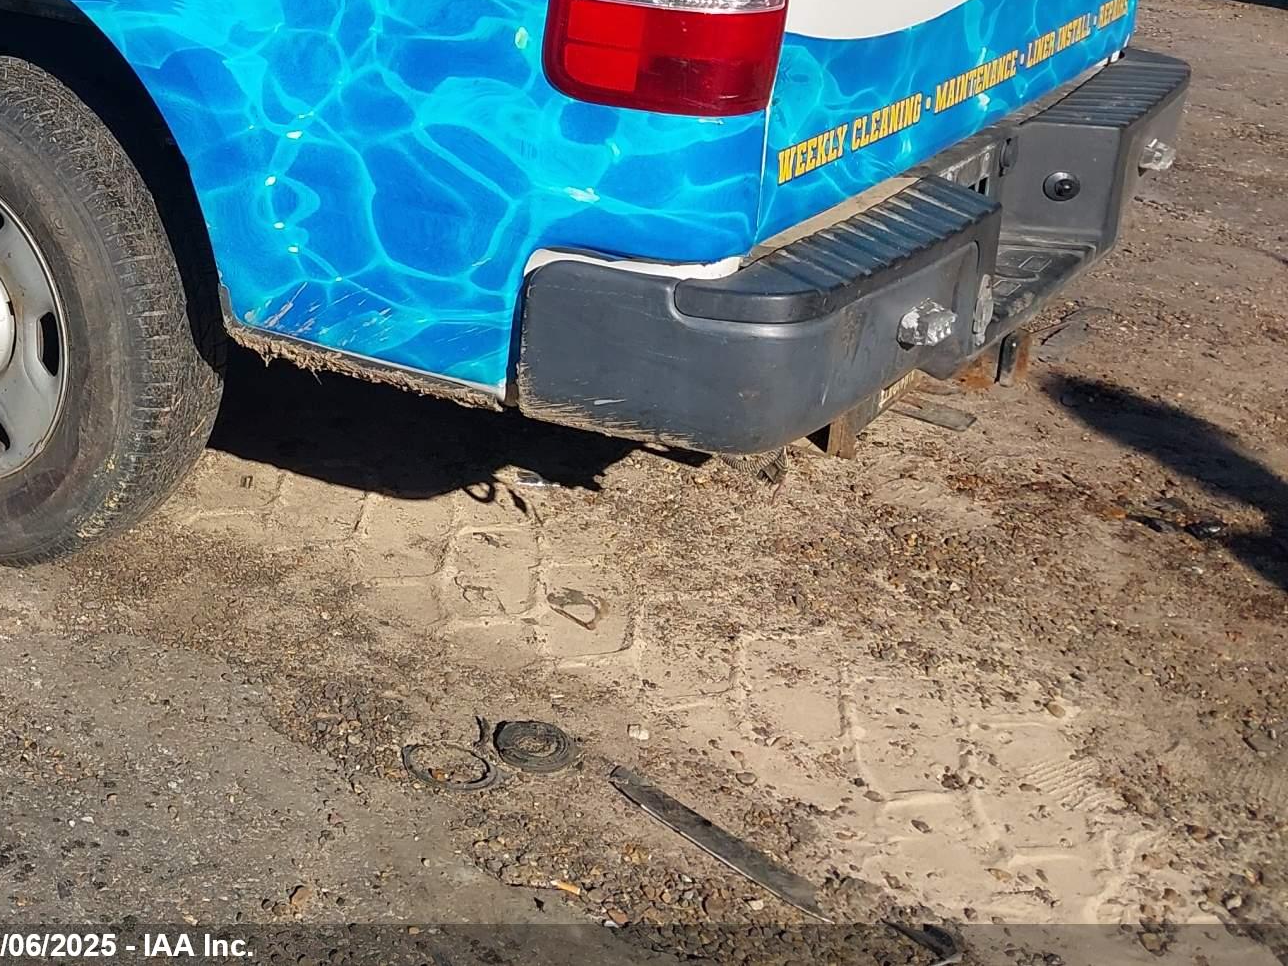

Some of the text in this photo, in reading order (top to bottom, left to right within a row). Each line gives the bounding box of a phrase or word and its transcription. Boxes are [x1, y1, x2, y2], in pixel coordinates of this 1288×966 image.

[777, 122, 848, 185] WEEKLY
[850, 92, 924, 151] CLEANING
[934, 49, 1018, 114] MAINTENANCE
[1026, 34, 1056, 68] LINER
